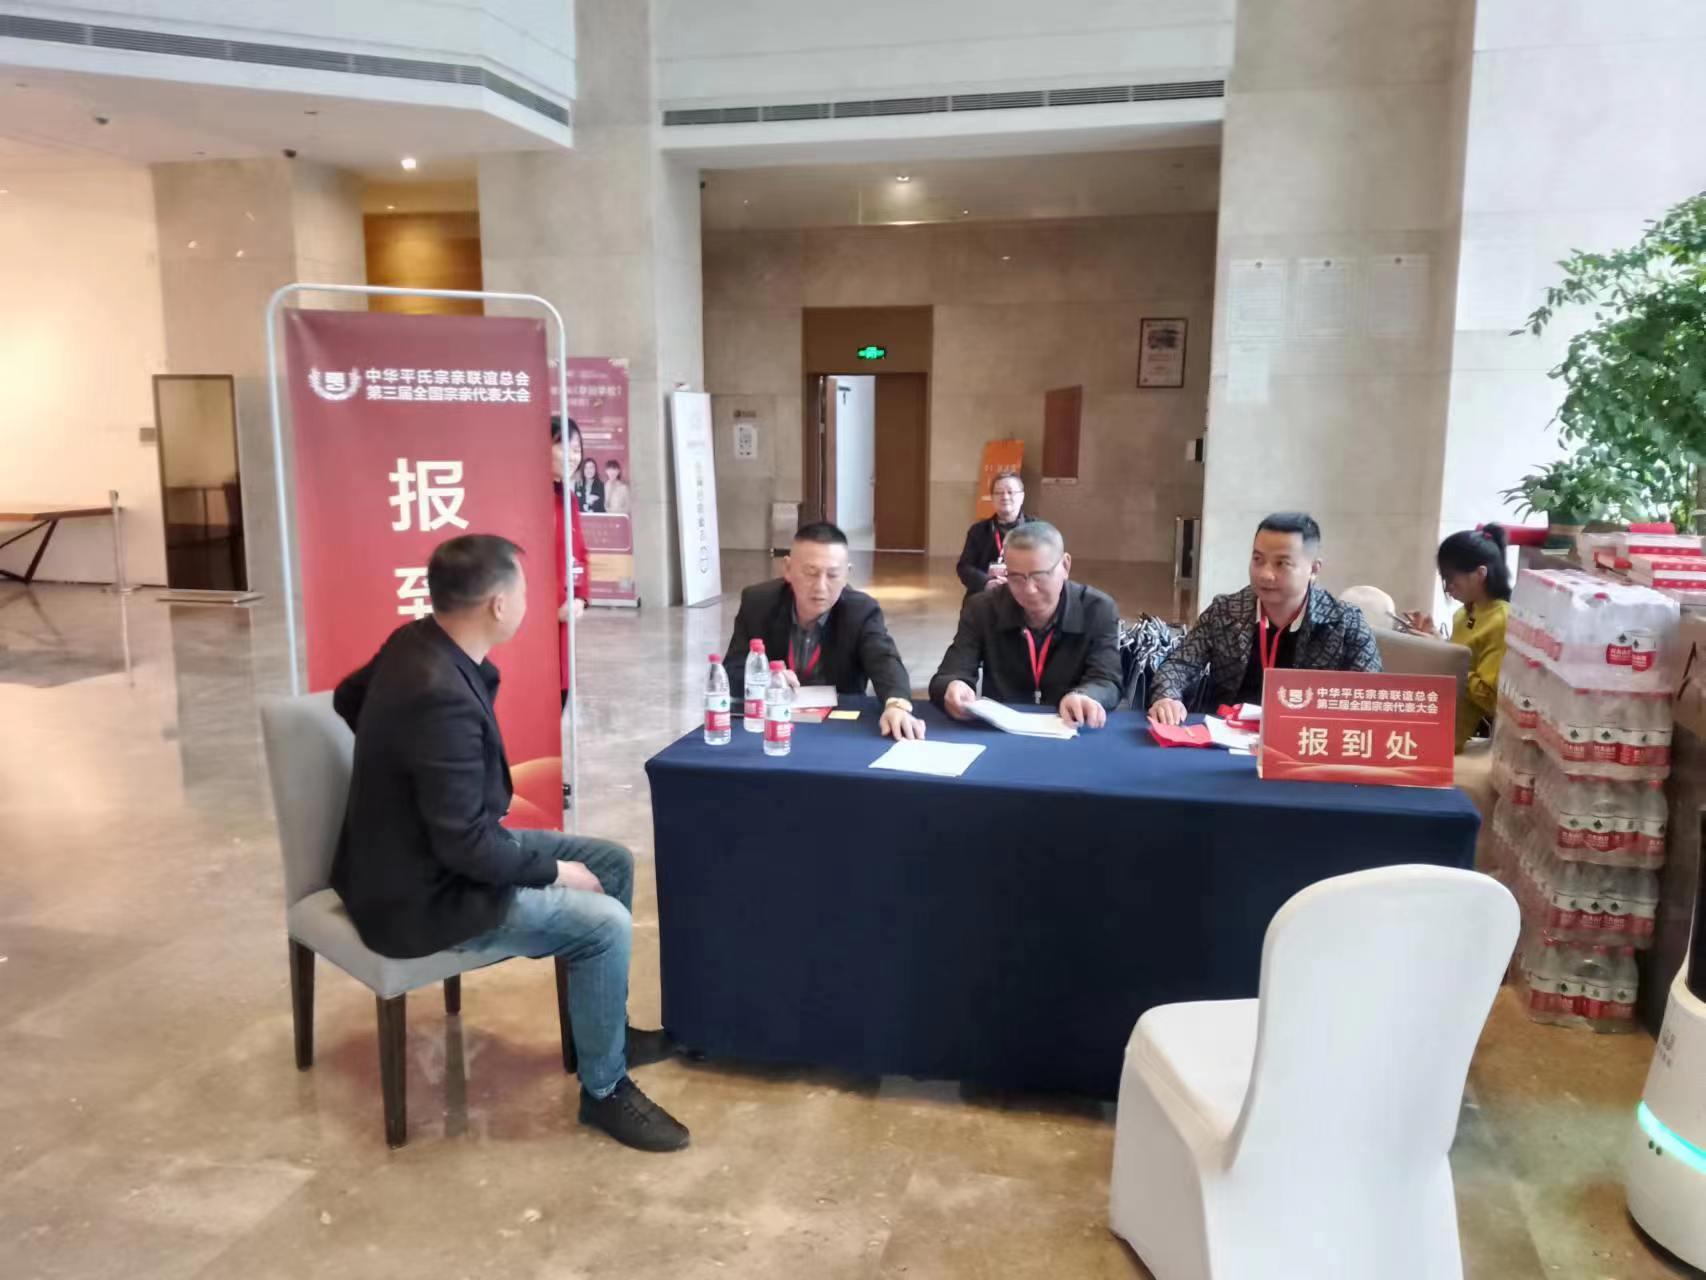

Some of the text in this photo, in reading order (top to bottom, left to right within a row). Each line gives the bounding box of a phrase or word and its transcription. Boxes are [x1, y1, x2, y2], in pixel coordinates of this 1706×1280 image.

[365, 368, 530, 386] 中华平氏宗亲联谊总会
[1298, 727, 1418, 760] 报到处
